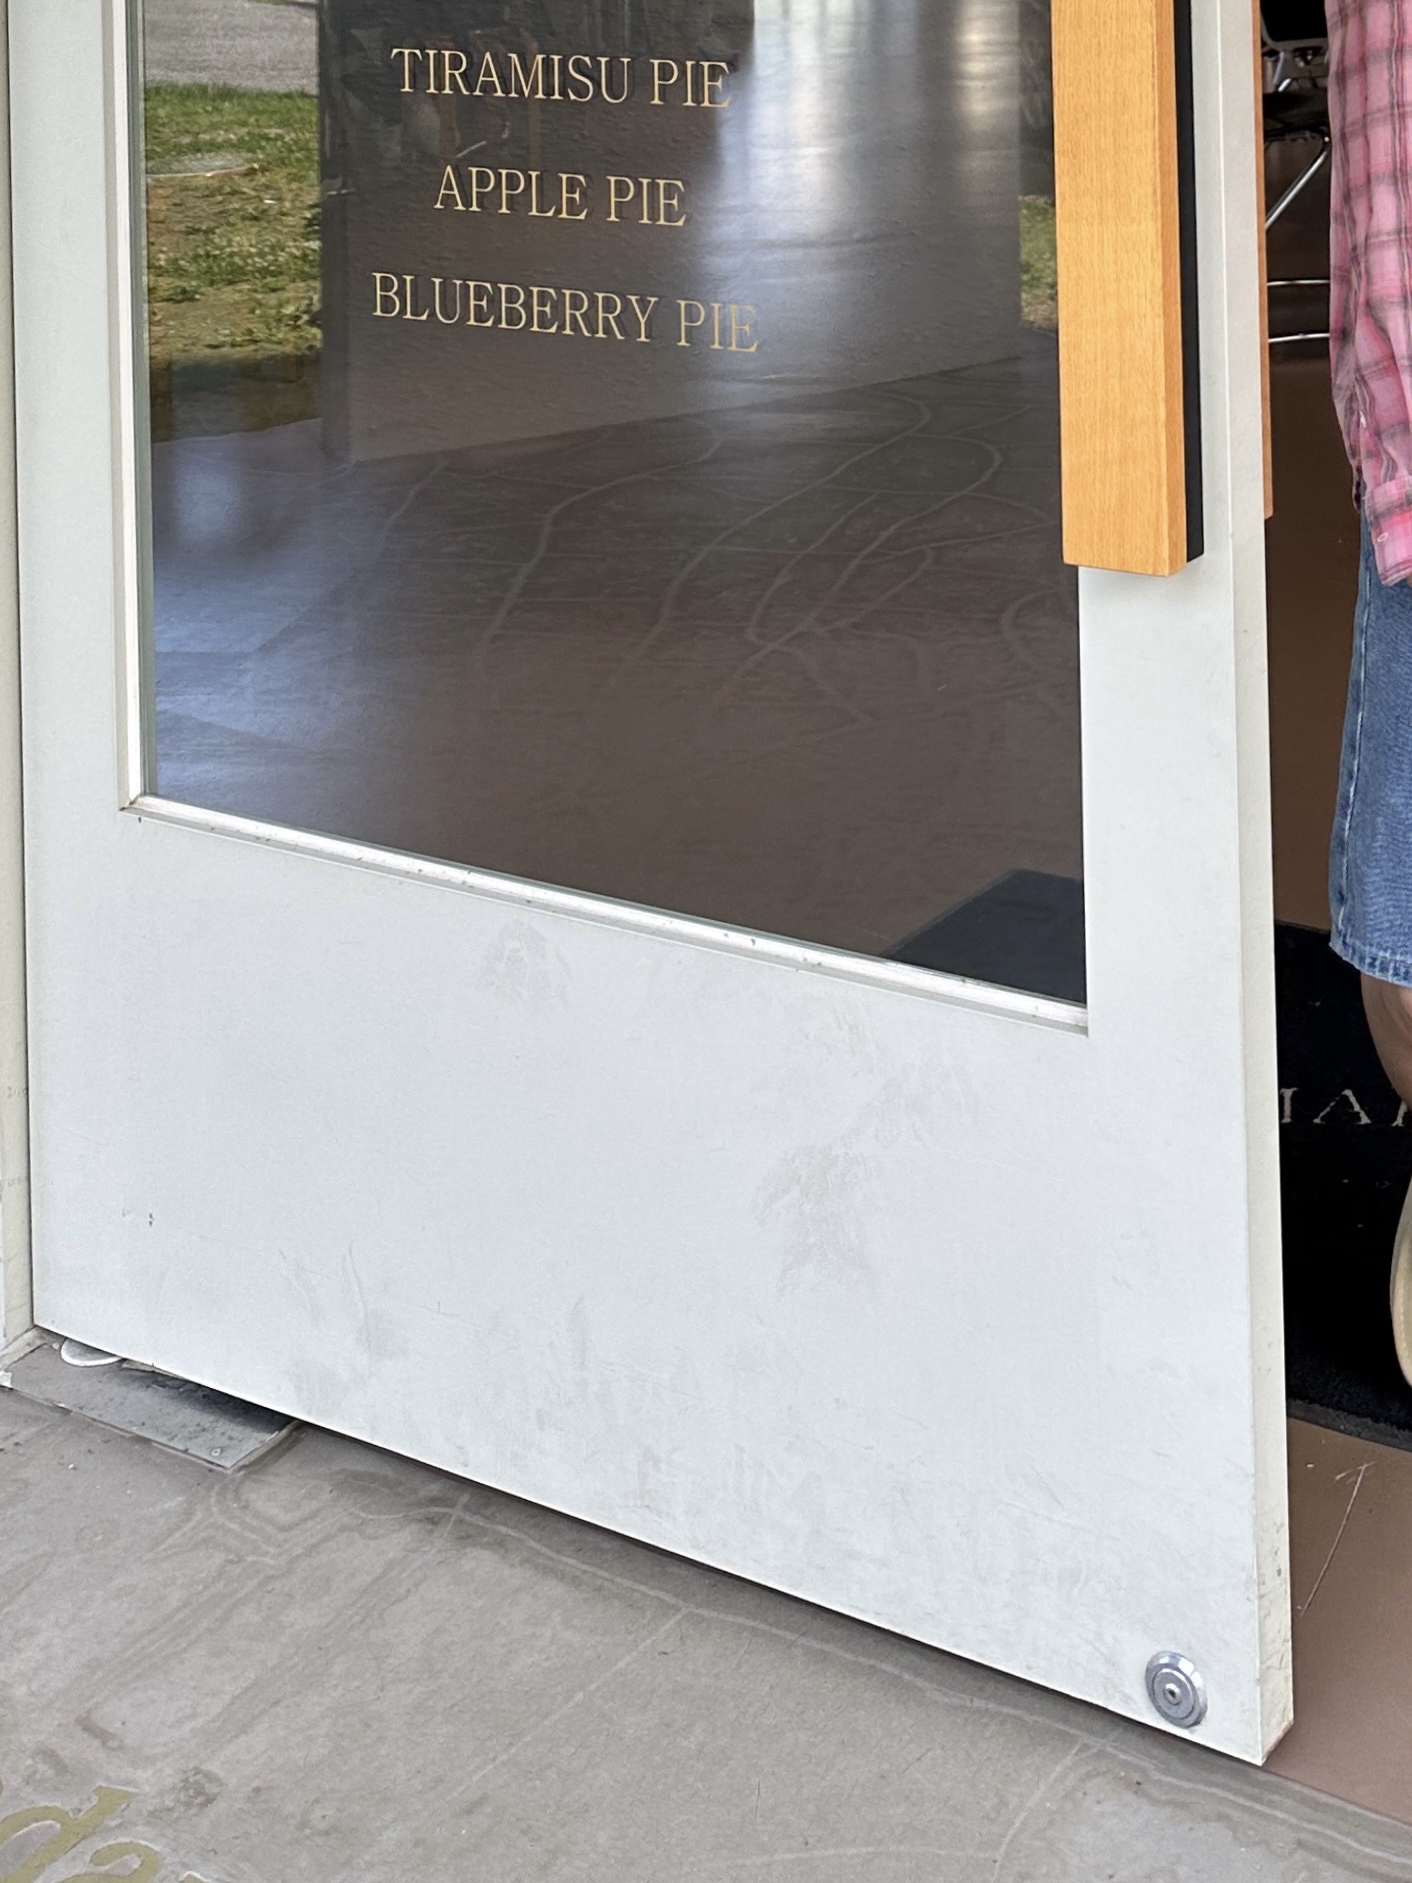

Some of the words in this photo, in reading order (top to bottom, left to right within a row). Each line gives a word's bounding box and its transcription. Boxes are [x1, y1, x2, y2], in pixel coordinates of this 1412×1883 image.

[391, 48, 633, 104] TIRAMISU
[649, 59, 731, 109] PIE
[433, 164, 588, 221] APPLE
[606, 175, 686, 227] PIE
[372, 272, 659, 343] BLUEBERRY
[675, 299, 759, 353] PIE
